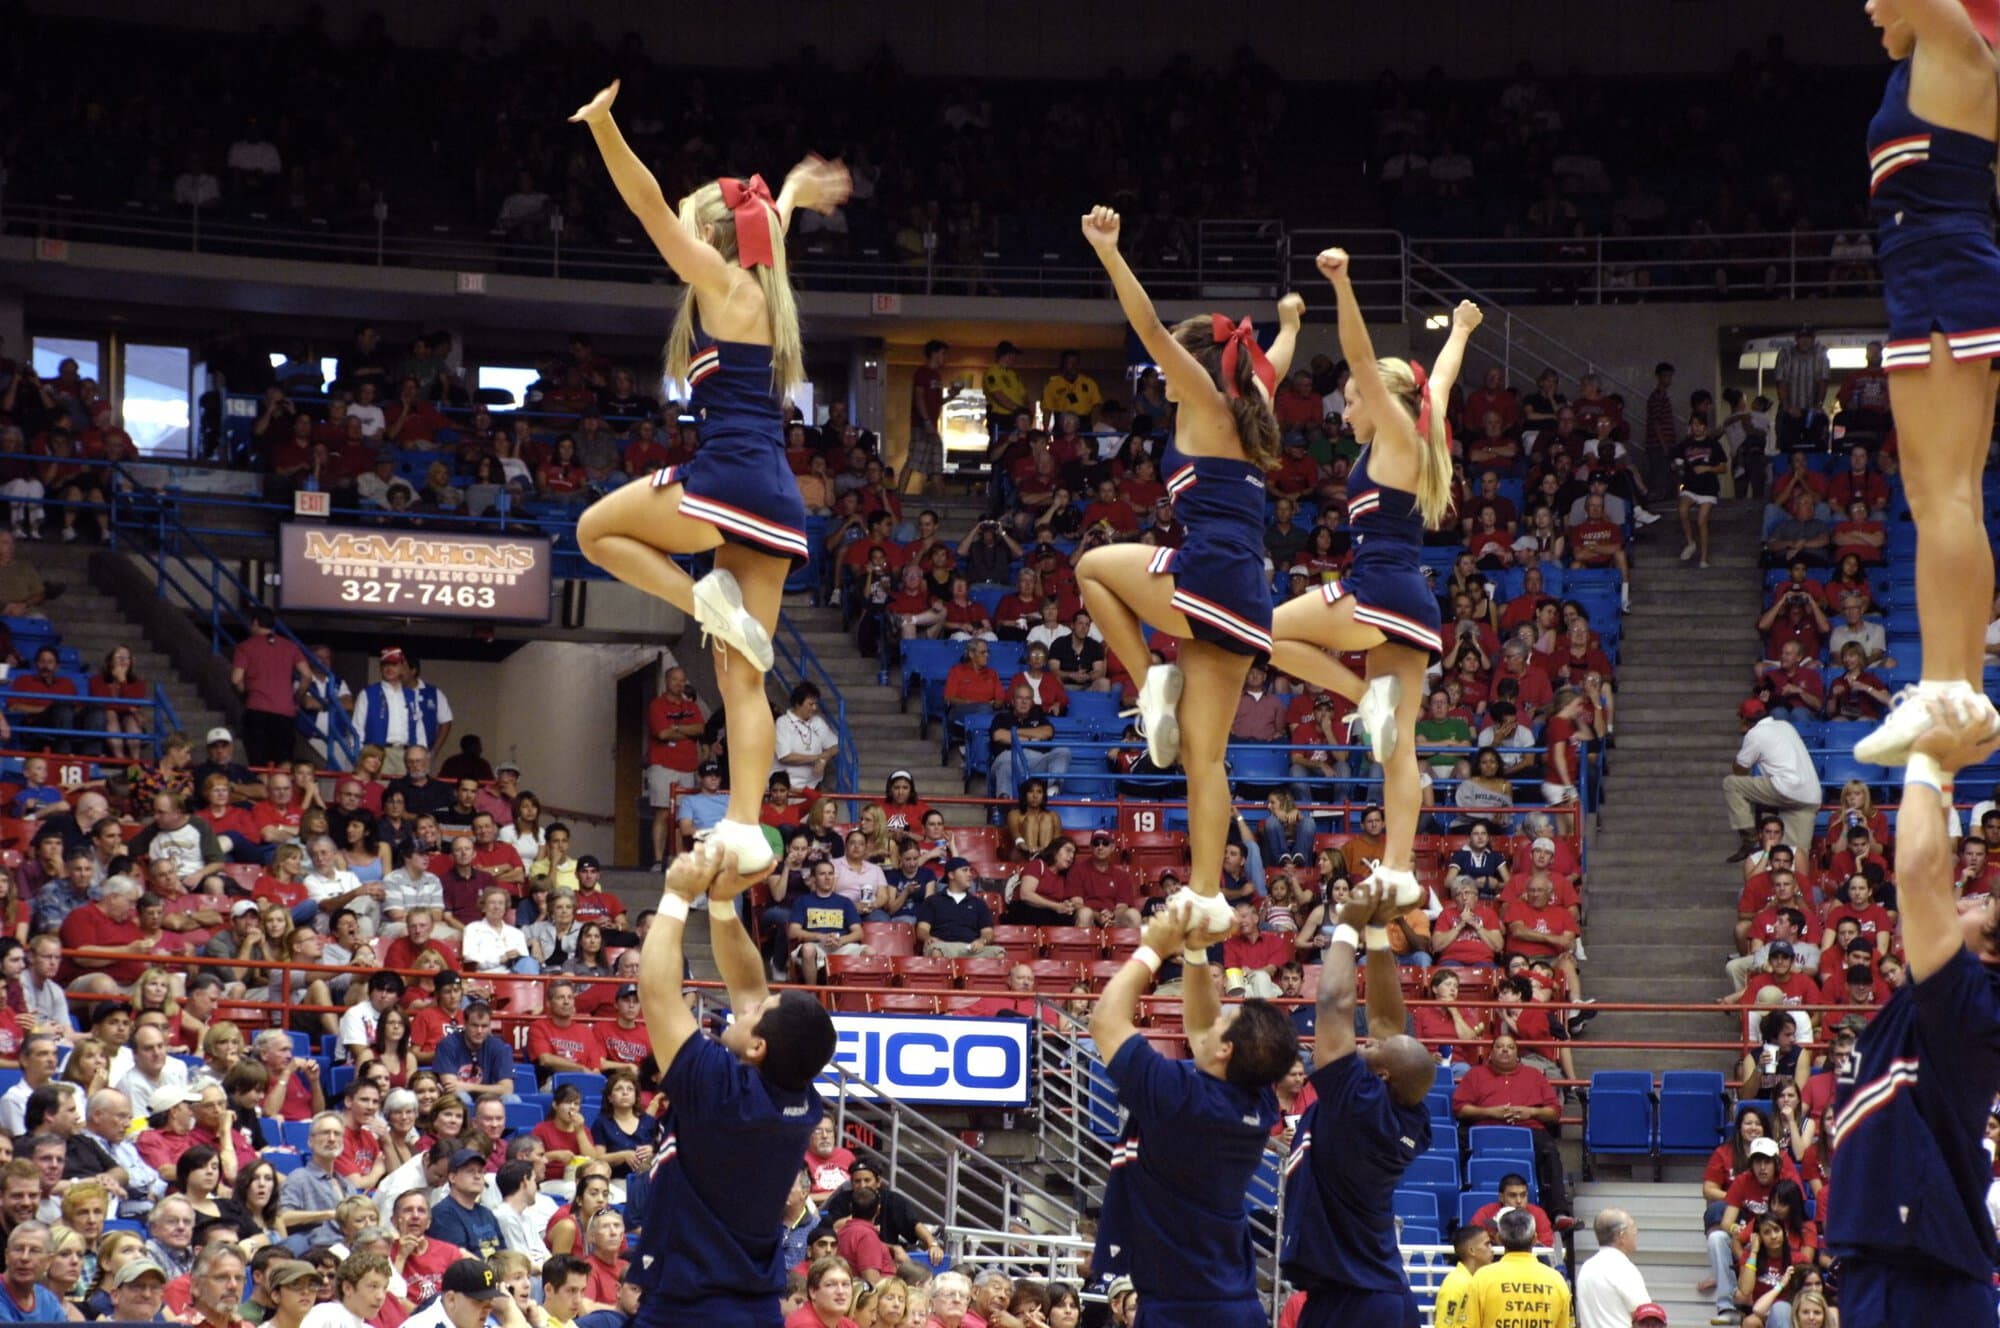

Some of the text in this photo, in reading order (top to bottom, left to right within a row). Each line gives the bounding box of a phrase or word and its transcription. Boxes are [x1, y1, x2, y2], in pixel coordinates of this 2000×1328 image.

[321, 564, 517, 586] PRIME STEAKHOUSE
[341, 580, 496, 609] 327-7463
[60, 765, 83, 785] 18
[1133, 811, 1156, 833] 19
[812, 1031, 1021, 1089] EICO
[846, 1123, 875, 1149] EXIT
[483, 1270, 493, 1287] P
[1501, 1282, 1553, 1295] EVENT
[1505, 1300, 1551, 1313] STAFF
[1495, 1318, 1553, 1328] SECURIT
